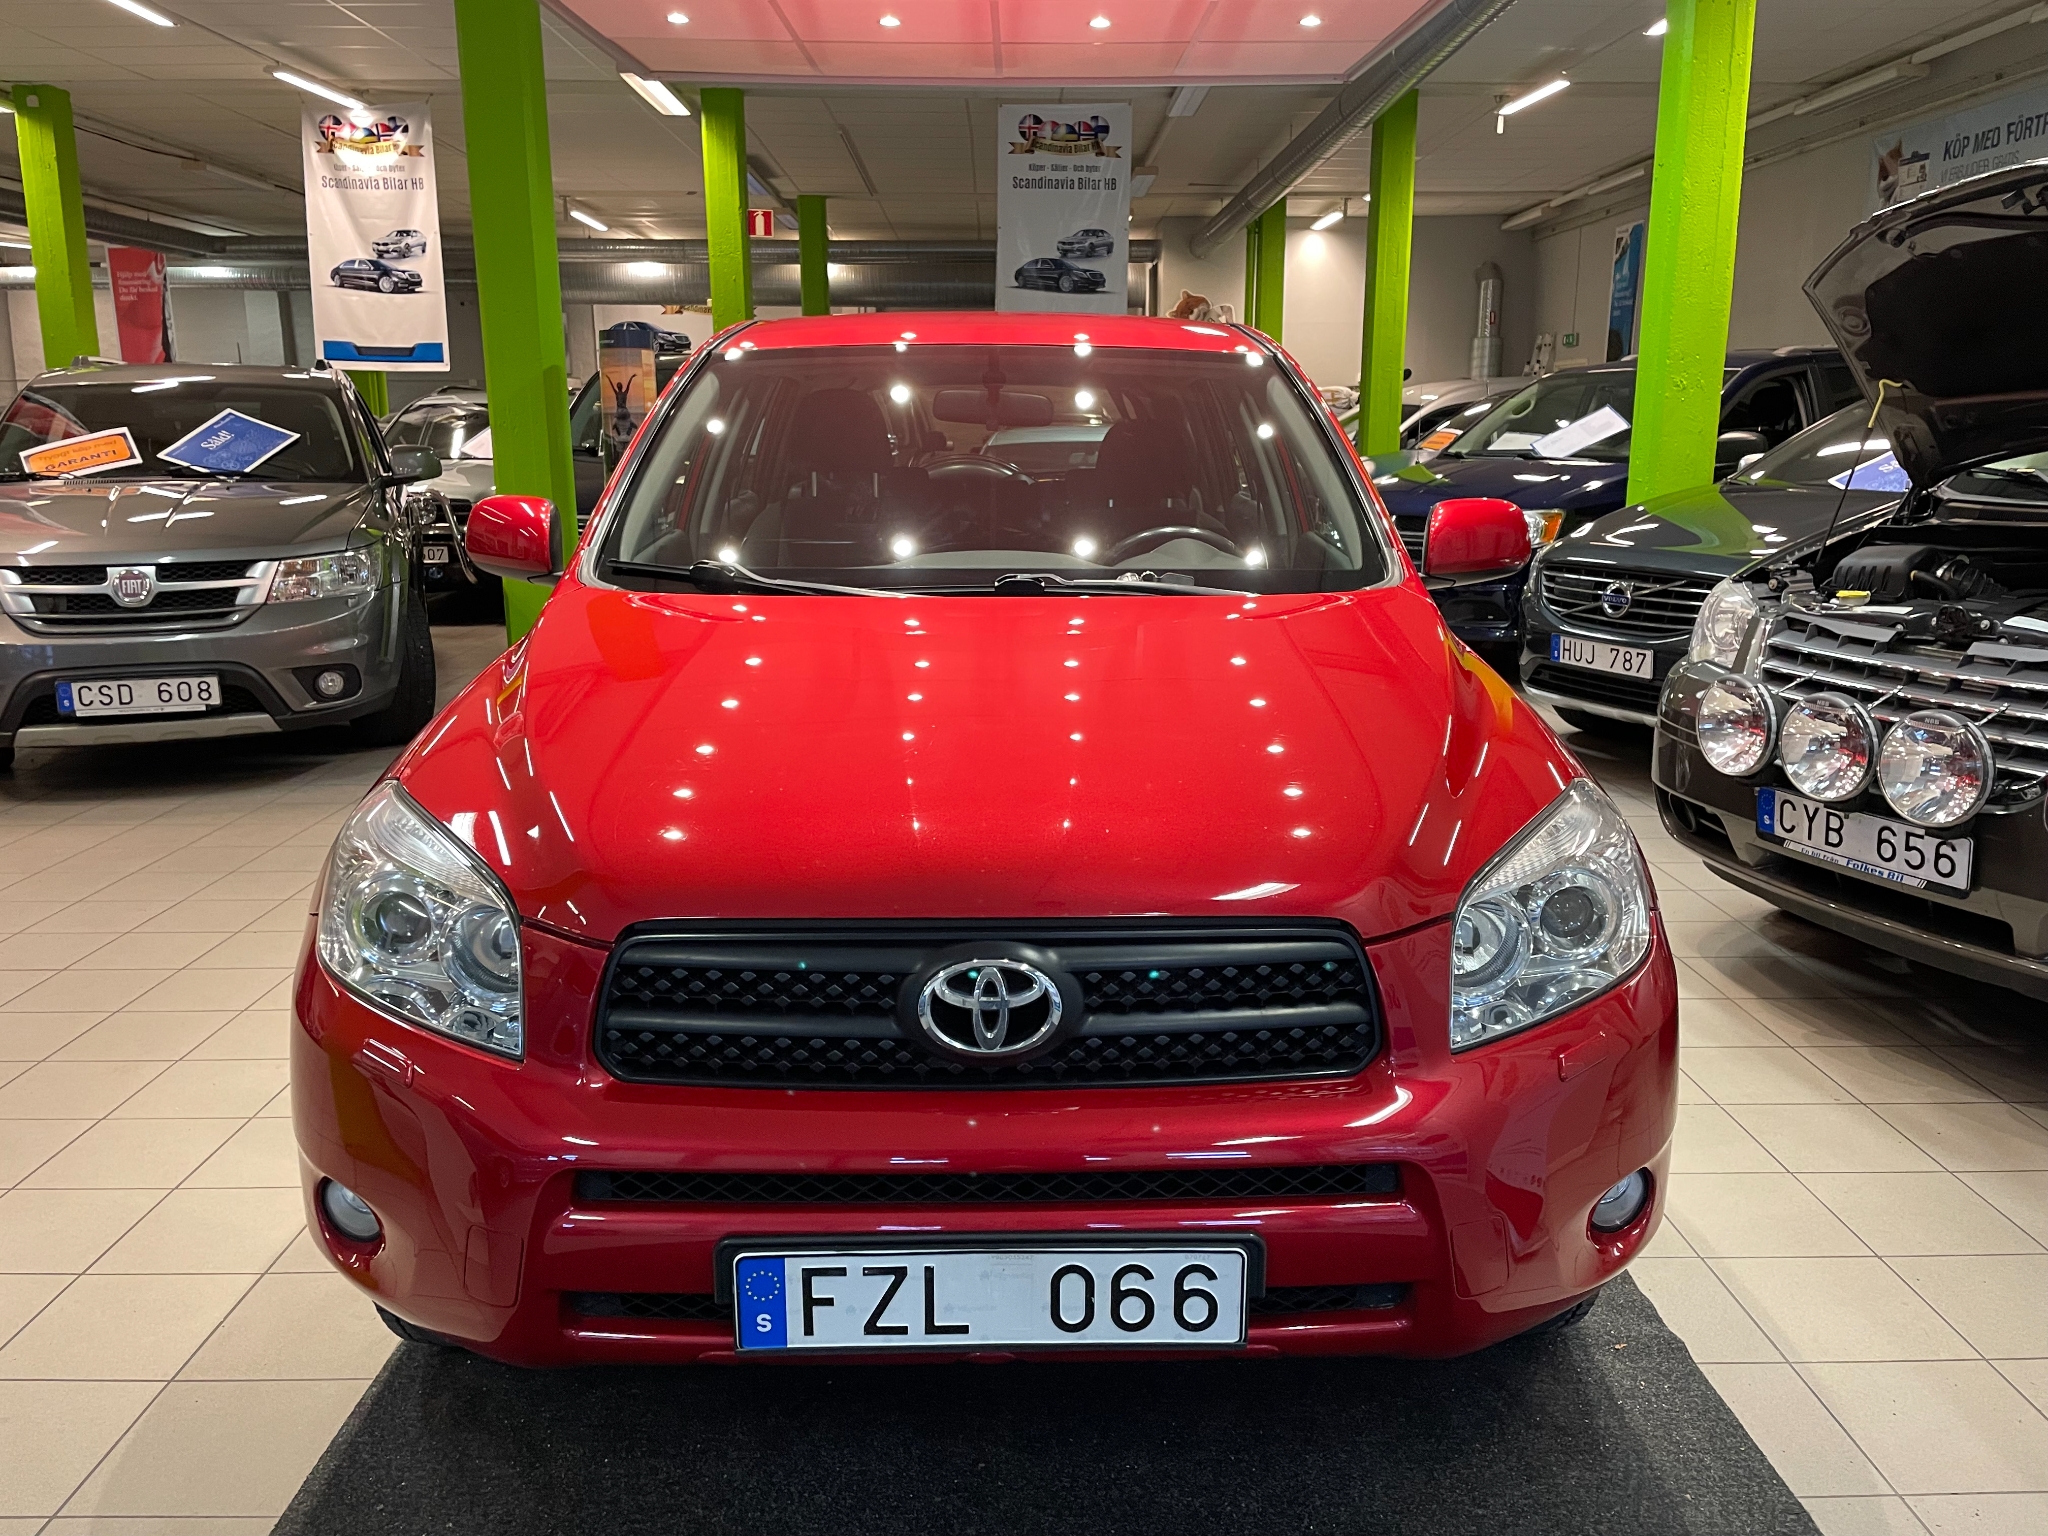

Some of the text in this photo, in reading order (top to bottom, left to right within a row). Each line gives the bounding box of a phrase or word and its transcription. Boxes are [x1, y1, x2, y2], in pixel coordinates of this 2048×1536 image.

[1943, 133, 1970, 161] KÖP
[1972, 126, 2001, 155] MED
[321, 175, 424, 190] Scandinavia Bilar HB
[1012, 176, 1117, 190] Scandinavia Bilar HB
[201, 430, 235, 450] Såld!
[45, 449, 117, 471] GARANTI
[121, 579, 142, 594] FIAT
[1603, 594, 1627, 604] VOLVO
[1562, 639, 1647, 673] HUJ 787
[77, 680, 212, 707] CSD 608
[1763, 814, 1771, 825] S
[1779, 799, 1957, 878] CYB 656
[1846, 858, 1884, 877] Folkes
[1886, 871, 1904, 883] Bil
[801, 1264, 1218, 1336] FZL 066
[756, 1313, 772, 1332] S
